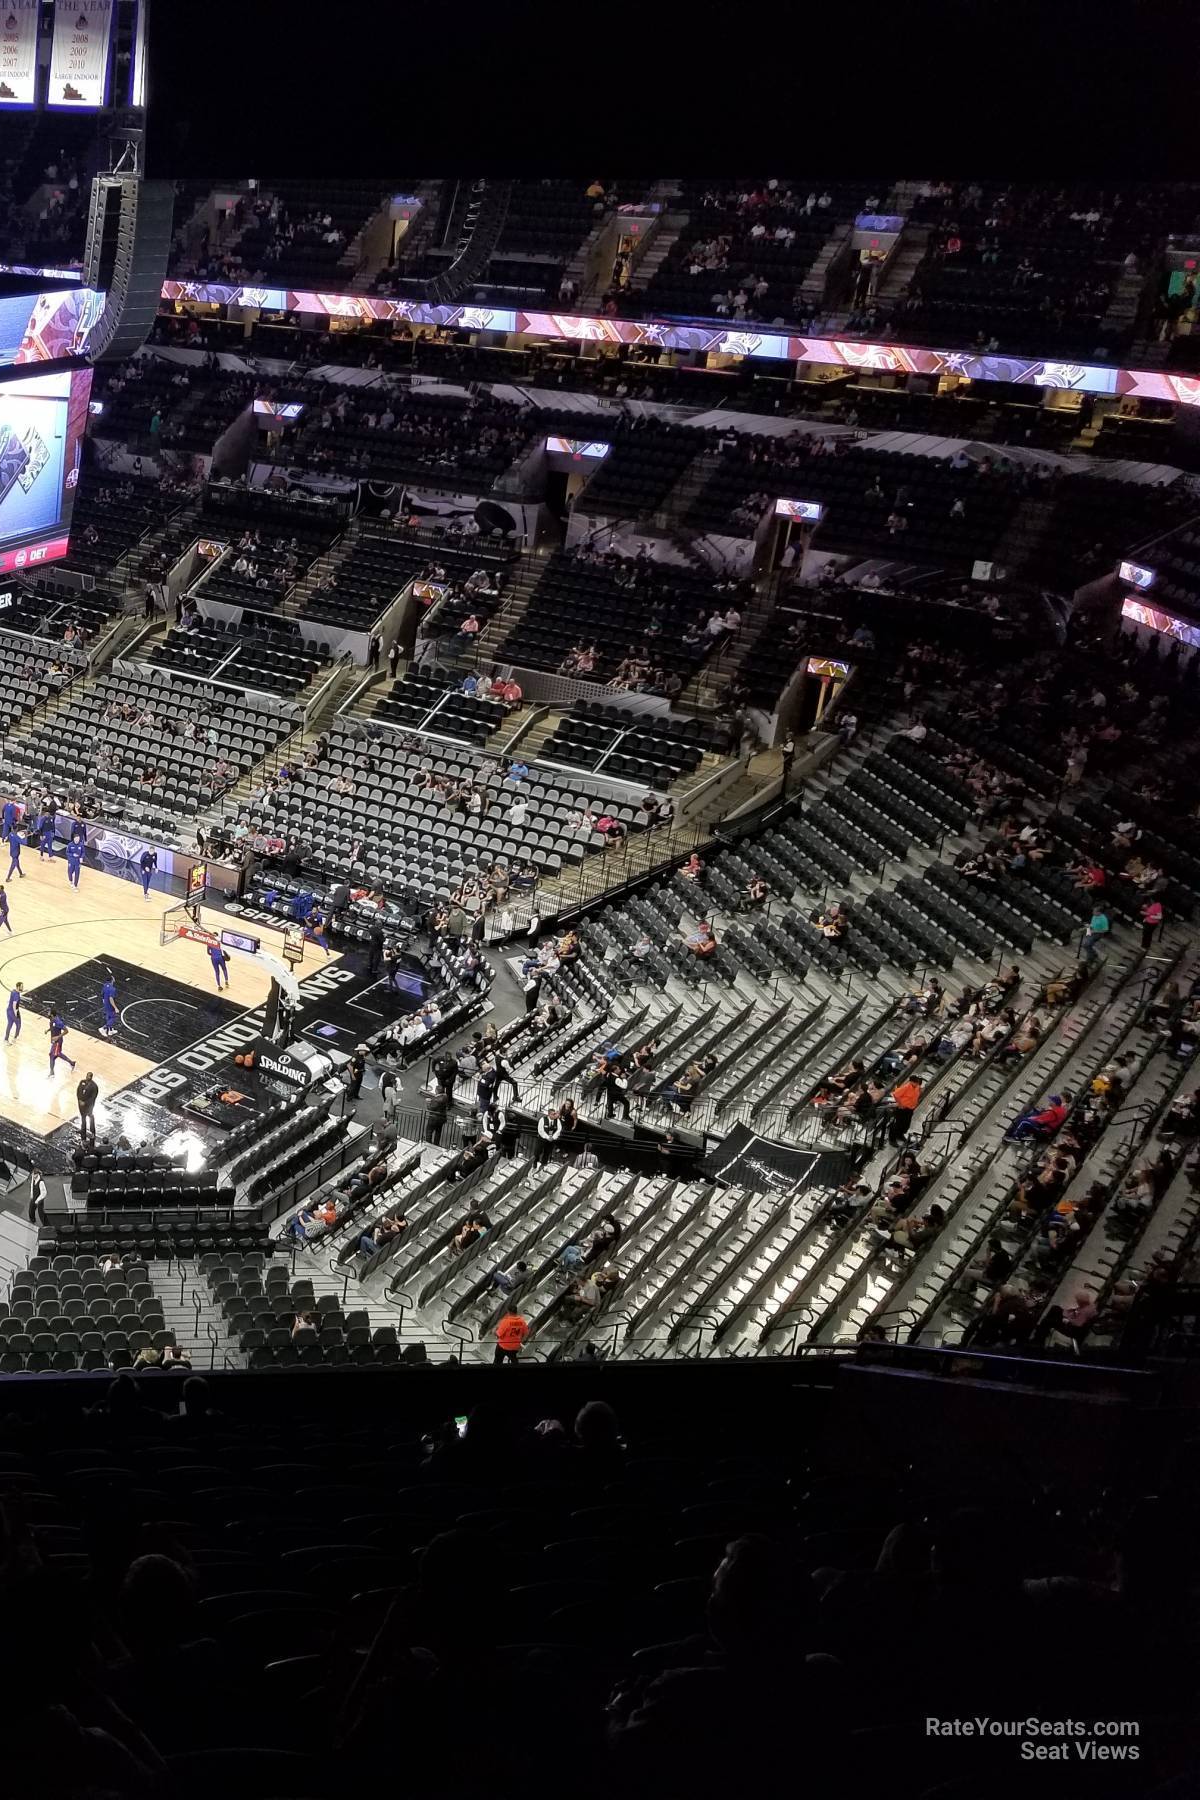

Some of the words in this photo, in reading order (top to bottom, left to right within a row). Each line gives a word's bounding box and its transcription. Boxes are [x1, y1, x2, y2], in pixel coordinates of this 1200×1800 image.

[72, 34, 88, 43] 2008
[2, 46, 18, 54] 2006
[70, 47, 87, 56] 2009
[2, 58, 17, 67] 2007
[69, 60, 85, 69] 2010
[30, 547, 48, 561] DET
[300, 966, 356, 1001] SAN
[259, 1055, 307, 1085] SPALDING
